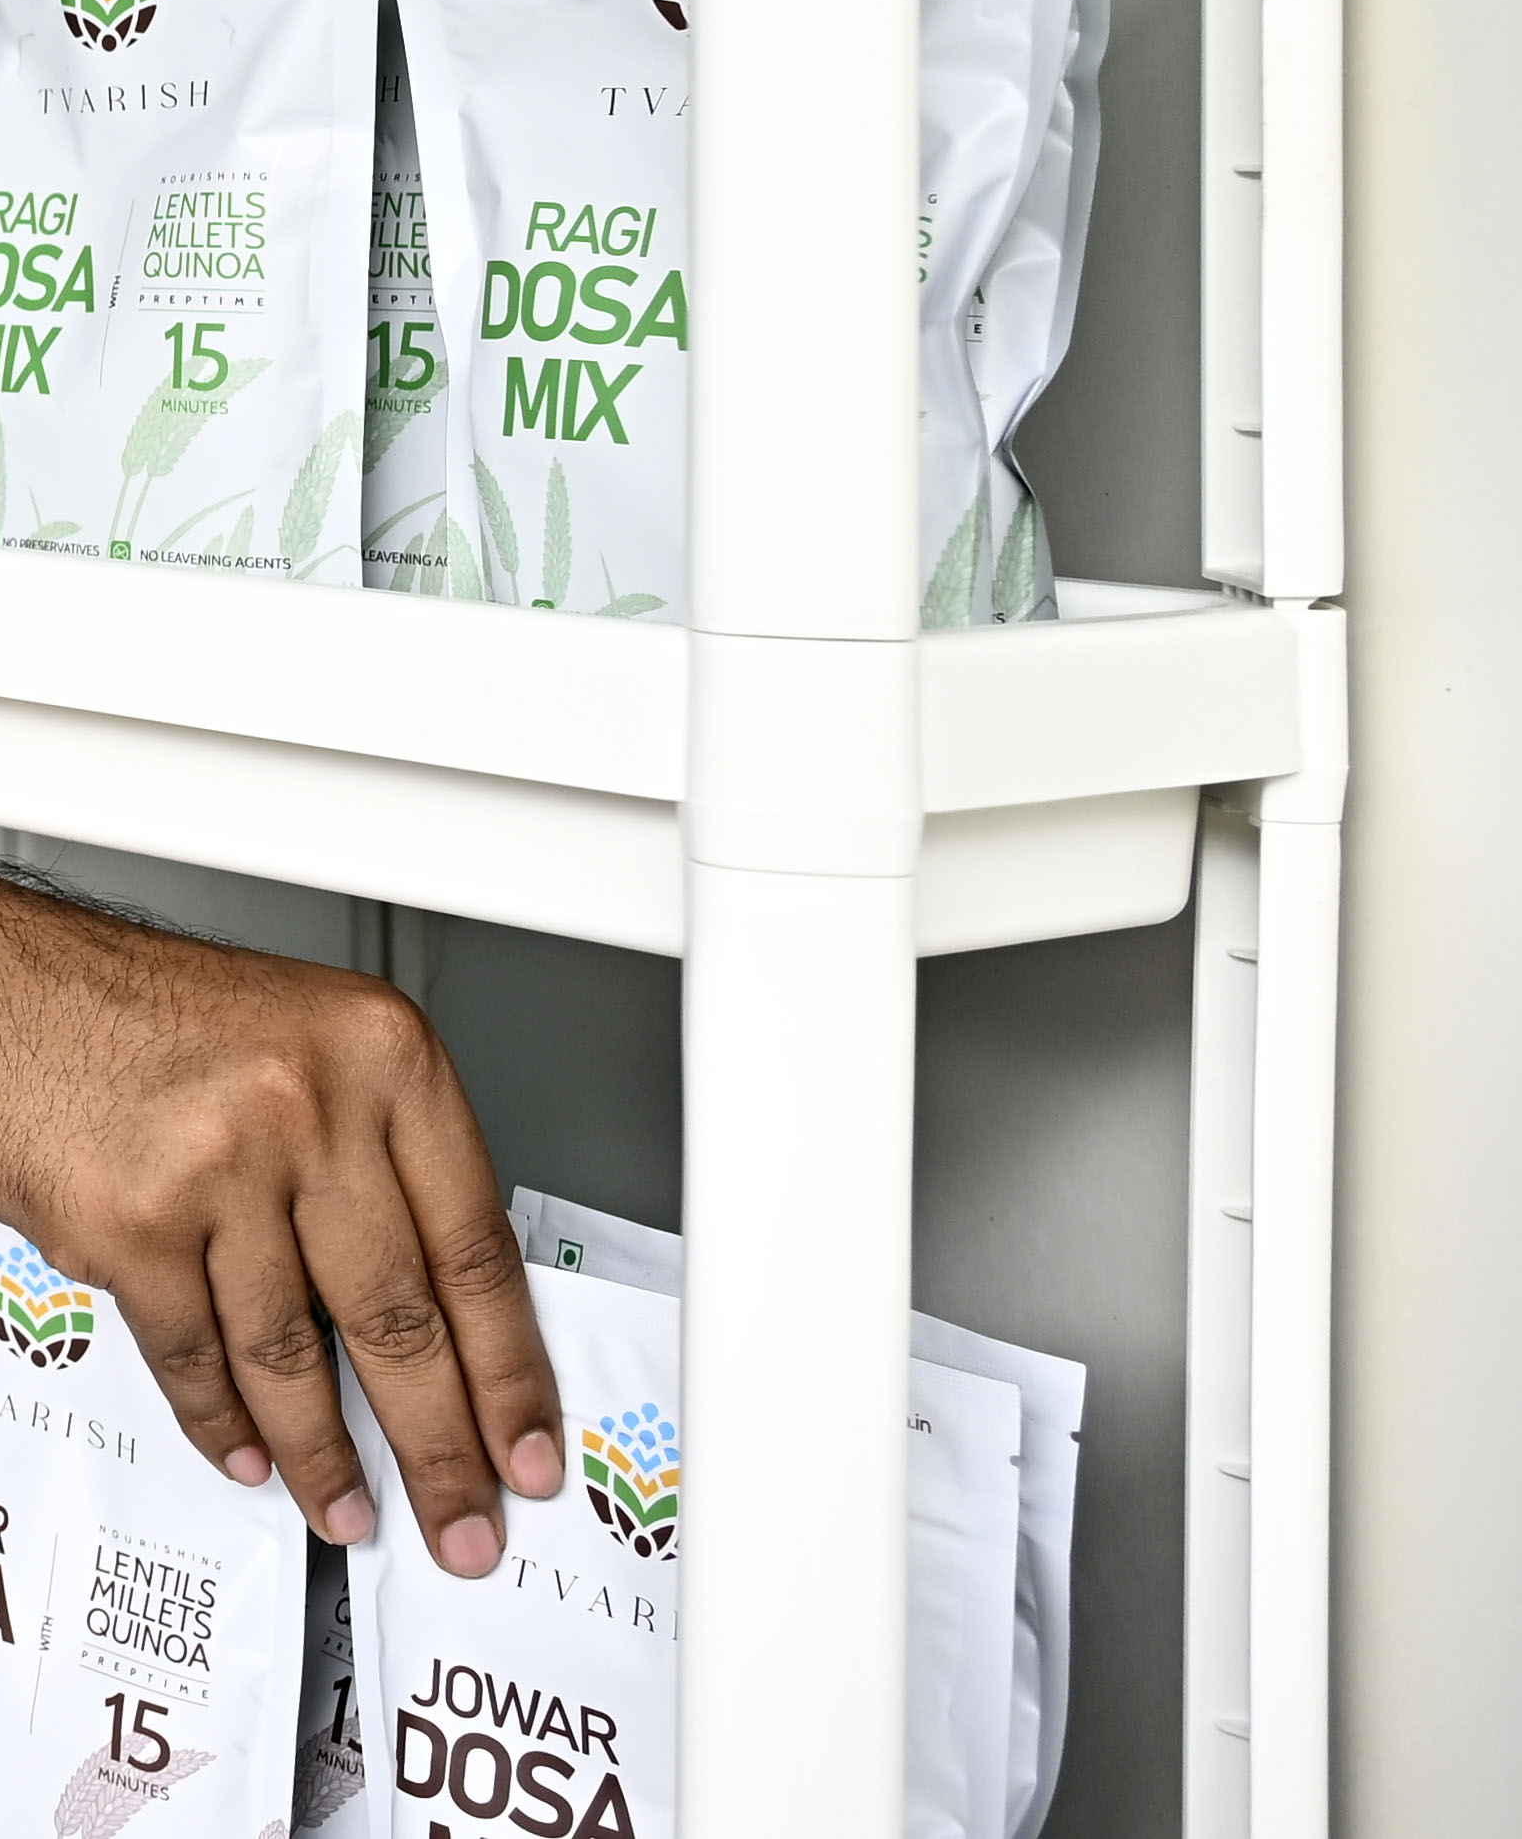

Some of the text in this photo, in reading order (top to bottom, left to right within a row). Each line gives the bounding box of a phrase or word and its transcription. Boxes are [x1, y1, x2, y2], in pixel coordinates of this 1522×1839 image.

[38, 80, 209, 114] TVARISH
[160, 170, 268, 185] NOURISHING
[154, 191, 266, 219] LENTILS
[147, 222, 266, 249] MILLETS
[525, 201, 657, 258] RAGI
[143, 252, 265, 281] QUINOA
[108, 275, 121, 309] WITH
[139, 294, 265, 307] PREPTIME
[480, 260, 688, 351] DOSA
[164, 321, 229, 393] 15
[367, 321, 435, 391] 15
[160, 399, 228, 415] MINUTES
[503, 356, 644, 445] MIX
[20, 539, 100, 557] PRESERVATIVES
[140, 549, 292, 570] NO LEAVENING AGENTS
[363, 549, 431, 567] LEAVENING
[98, 1523, 222, 1571] NOURISHING
[94, 1544, 216, 1609] LENTILS
[89, 1575, 213, 1640] MILLETS
[86, 1608, 210, 1673] QUINOA
[81, 1649, 209, 1700] PREPTIME
[105, 1691, 171, 1773] 15
[411, 1658, 620, 1766] JOWAR
[97, 1767, 170, 1802] MINUTES
[396, 1707, 636, 1839] DOSA
